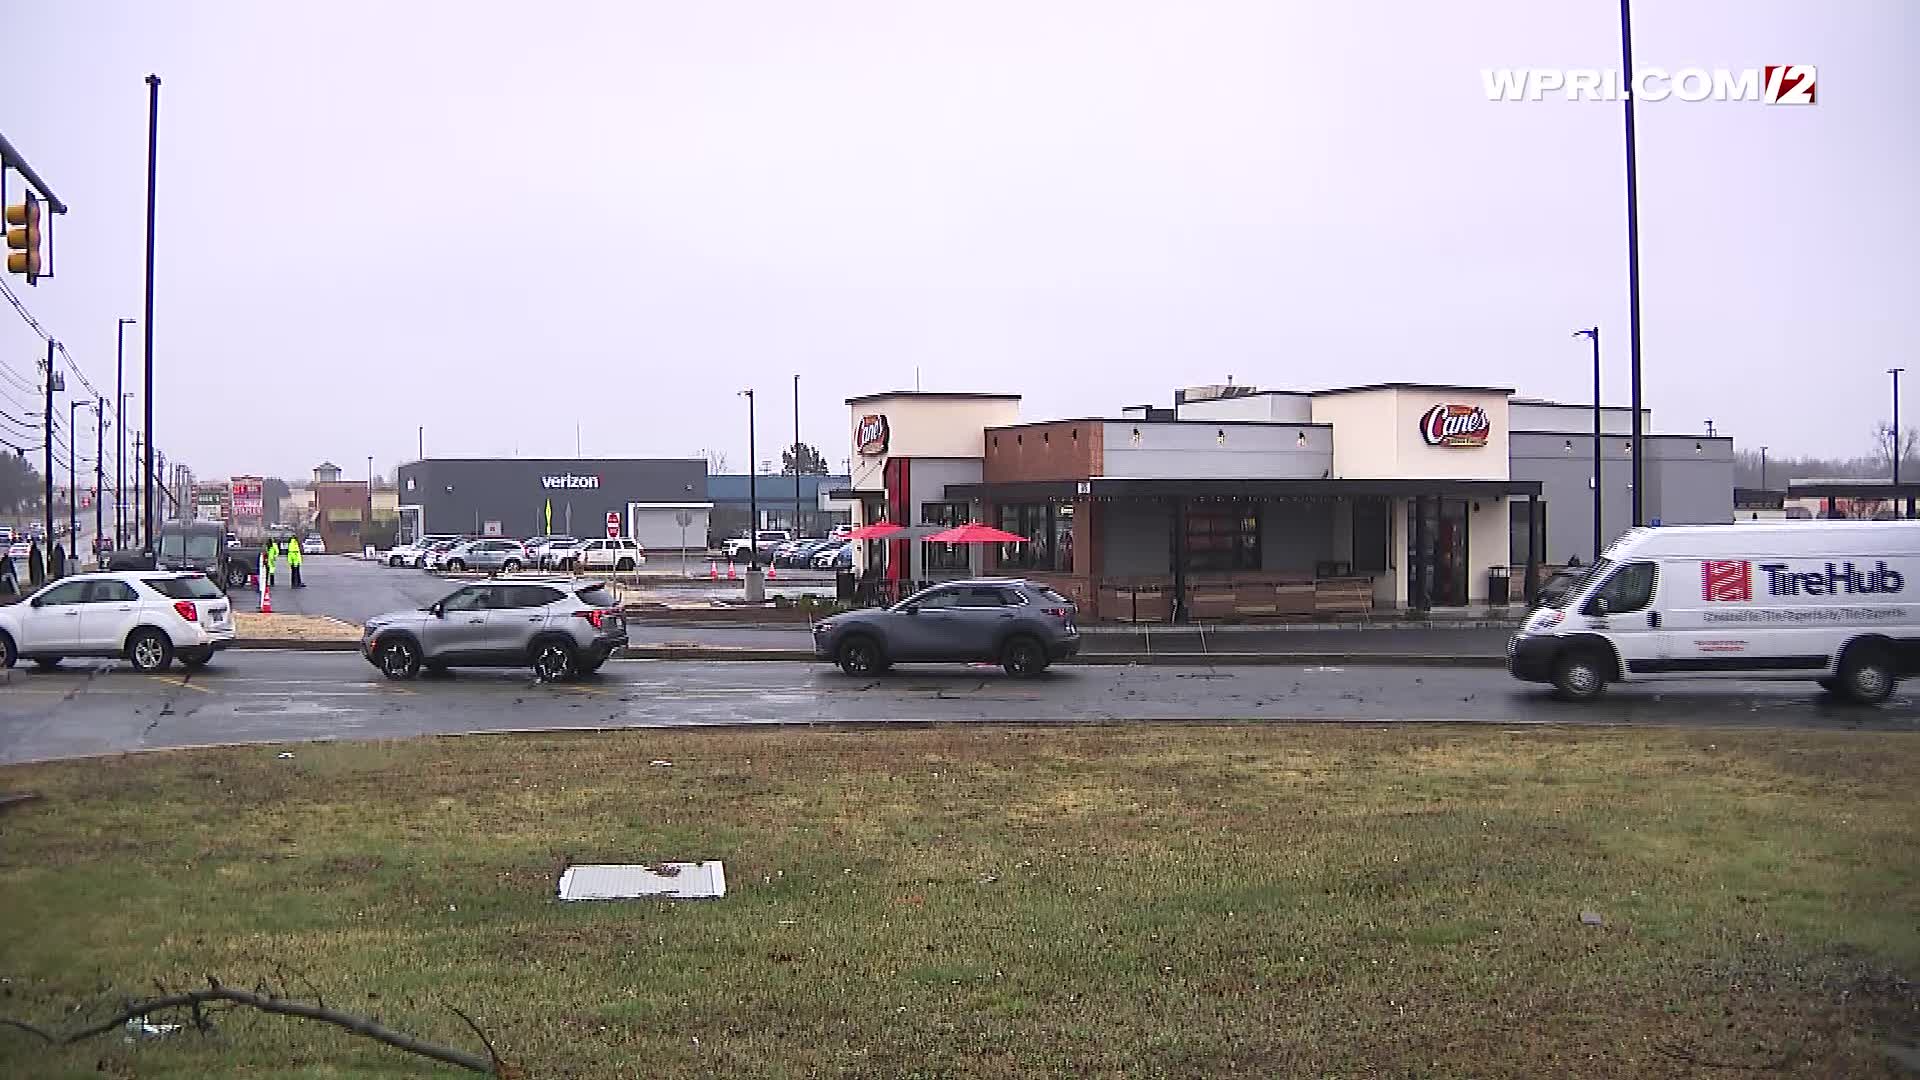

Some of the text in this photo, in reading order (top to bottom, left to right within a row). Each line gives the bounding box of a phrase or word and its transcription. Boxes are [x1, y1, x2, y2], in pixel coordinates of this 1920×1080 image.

[1427, 406, 1488, 443] Cane's
[542, 473, 599, 488] verizon
[1759, 561, 1904, 595] TireHub
